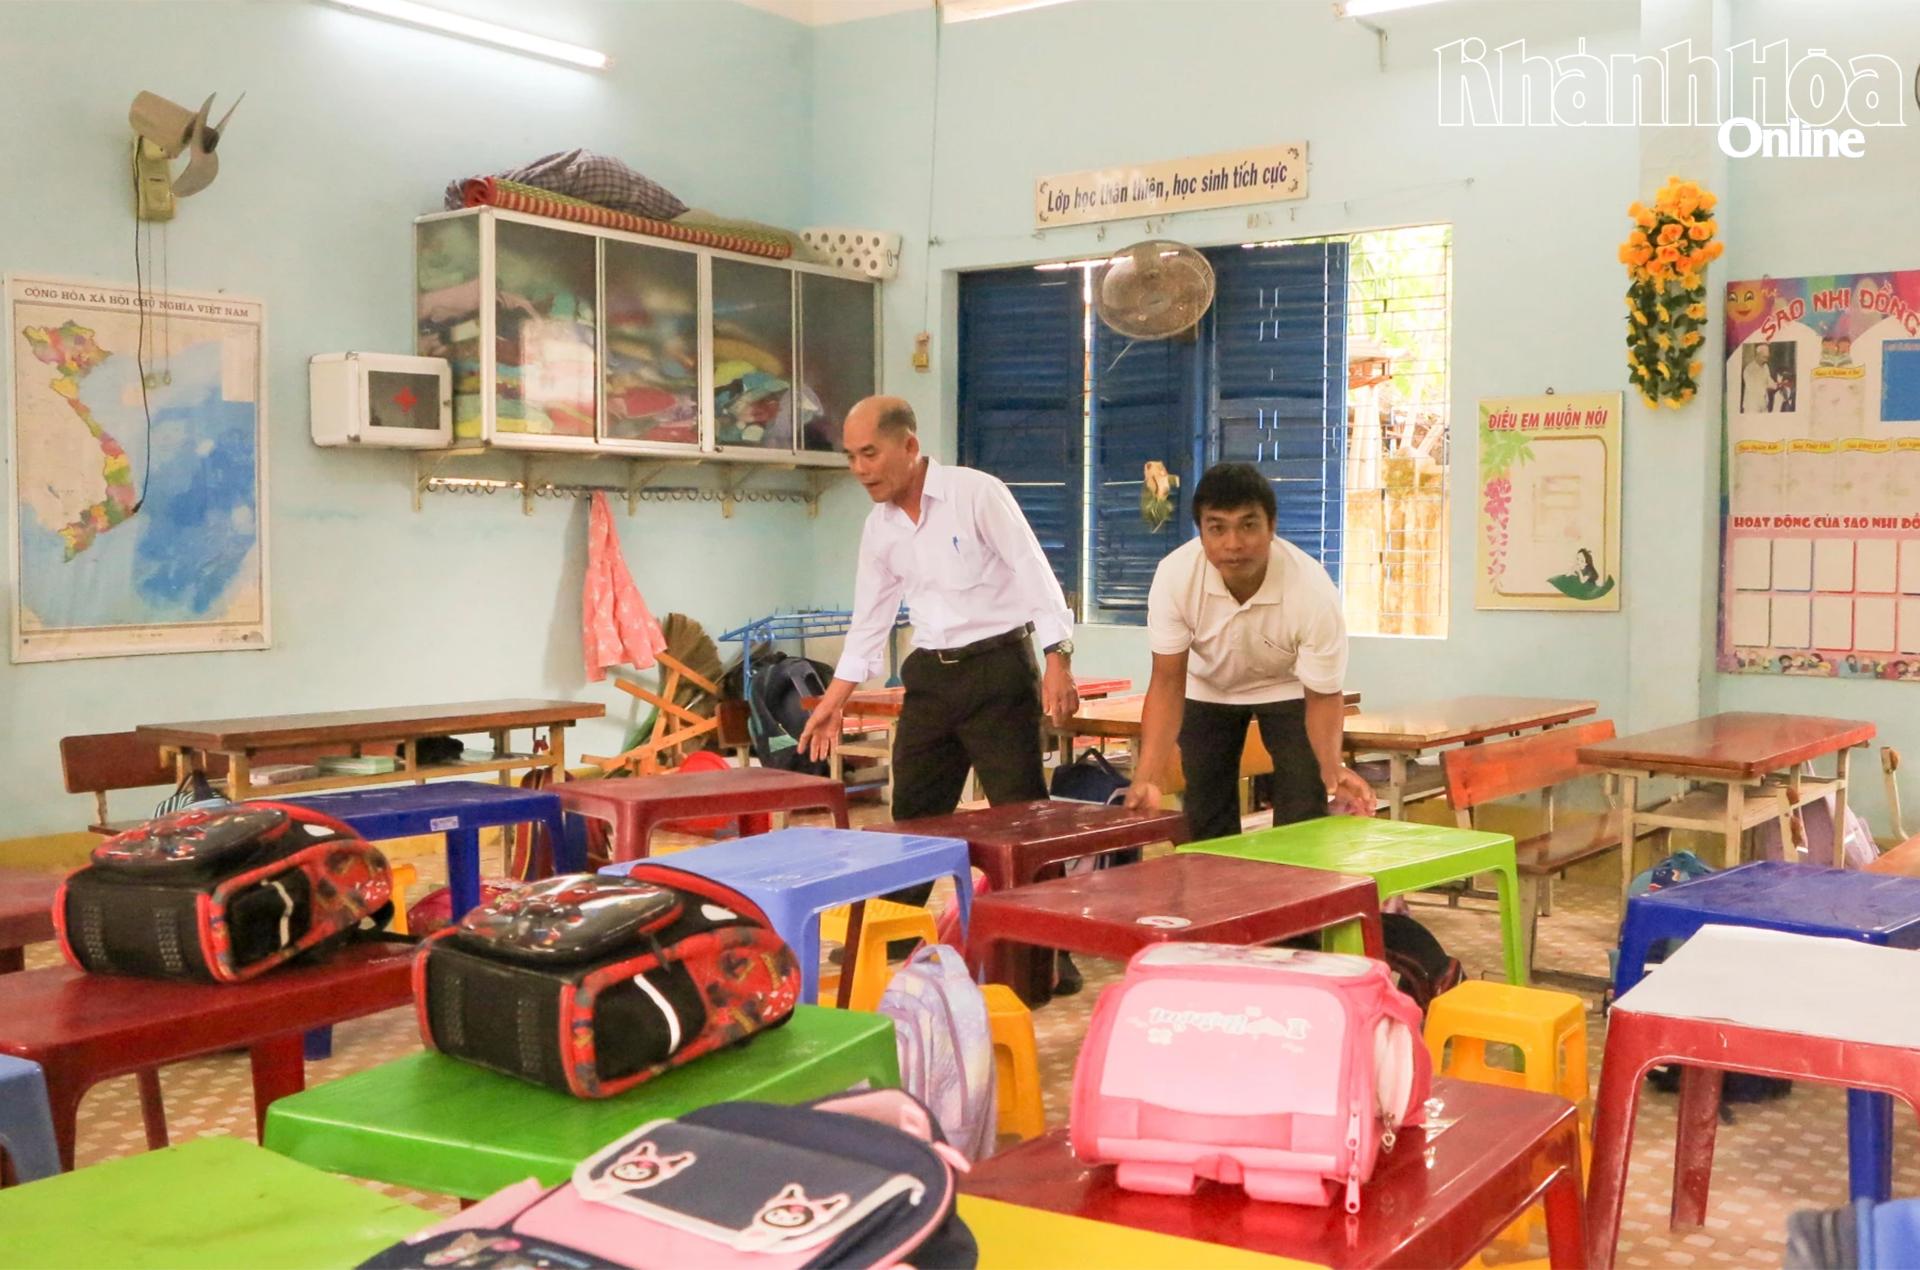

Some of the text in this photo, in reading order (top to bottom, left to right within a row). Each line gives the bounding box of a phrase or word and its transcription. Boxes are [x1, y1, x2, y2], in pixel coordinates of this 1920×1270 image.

[1047, 189, 1071, 215] Lớp
[1074, 186, 1097, 213] học
[1172, 173, 1198, 200] học
[1201, 167, 1229, 193] sinh
[1233, 160, 1259, 189] tích
[1262, 161, 1288, 189] cực
[225, 306, 249, 318] NAM
[1760, 279, 1920, 342] SAO NHI ĐỒNG
[1521, 412, 1540, 430] EM
[1543, 402, 1582, 429] MUỐN
[1585, 405, 1609, 428] NÓI
[1813, 513, 1841, 529] CỦA
[1843, 516, 1869, 529] SAO
[1871, 516, 1898, 529] NHI
